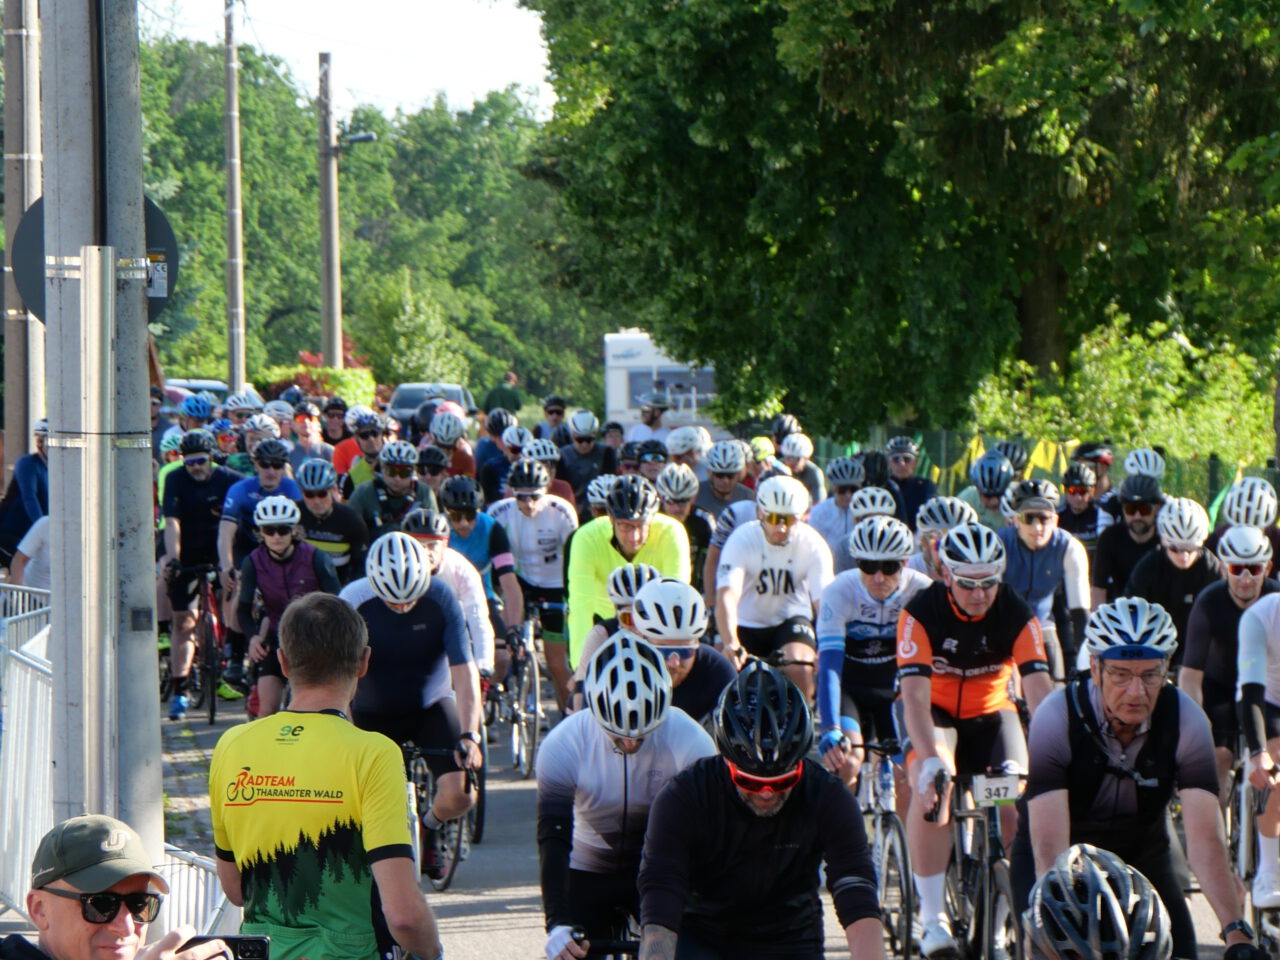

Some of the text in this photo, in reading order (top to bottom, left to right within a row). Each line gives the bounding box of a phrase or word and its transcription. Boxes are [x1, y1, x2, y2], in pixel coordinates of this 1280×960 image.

[255, 787, 344, 800] THARANDTER WALD
[984, 786, 1009, 800] 347
